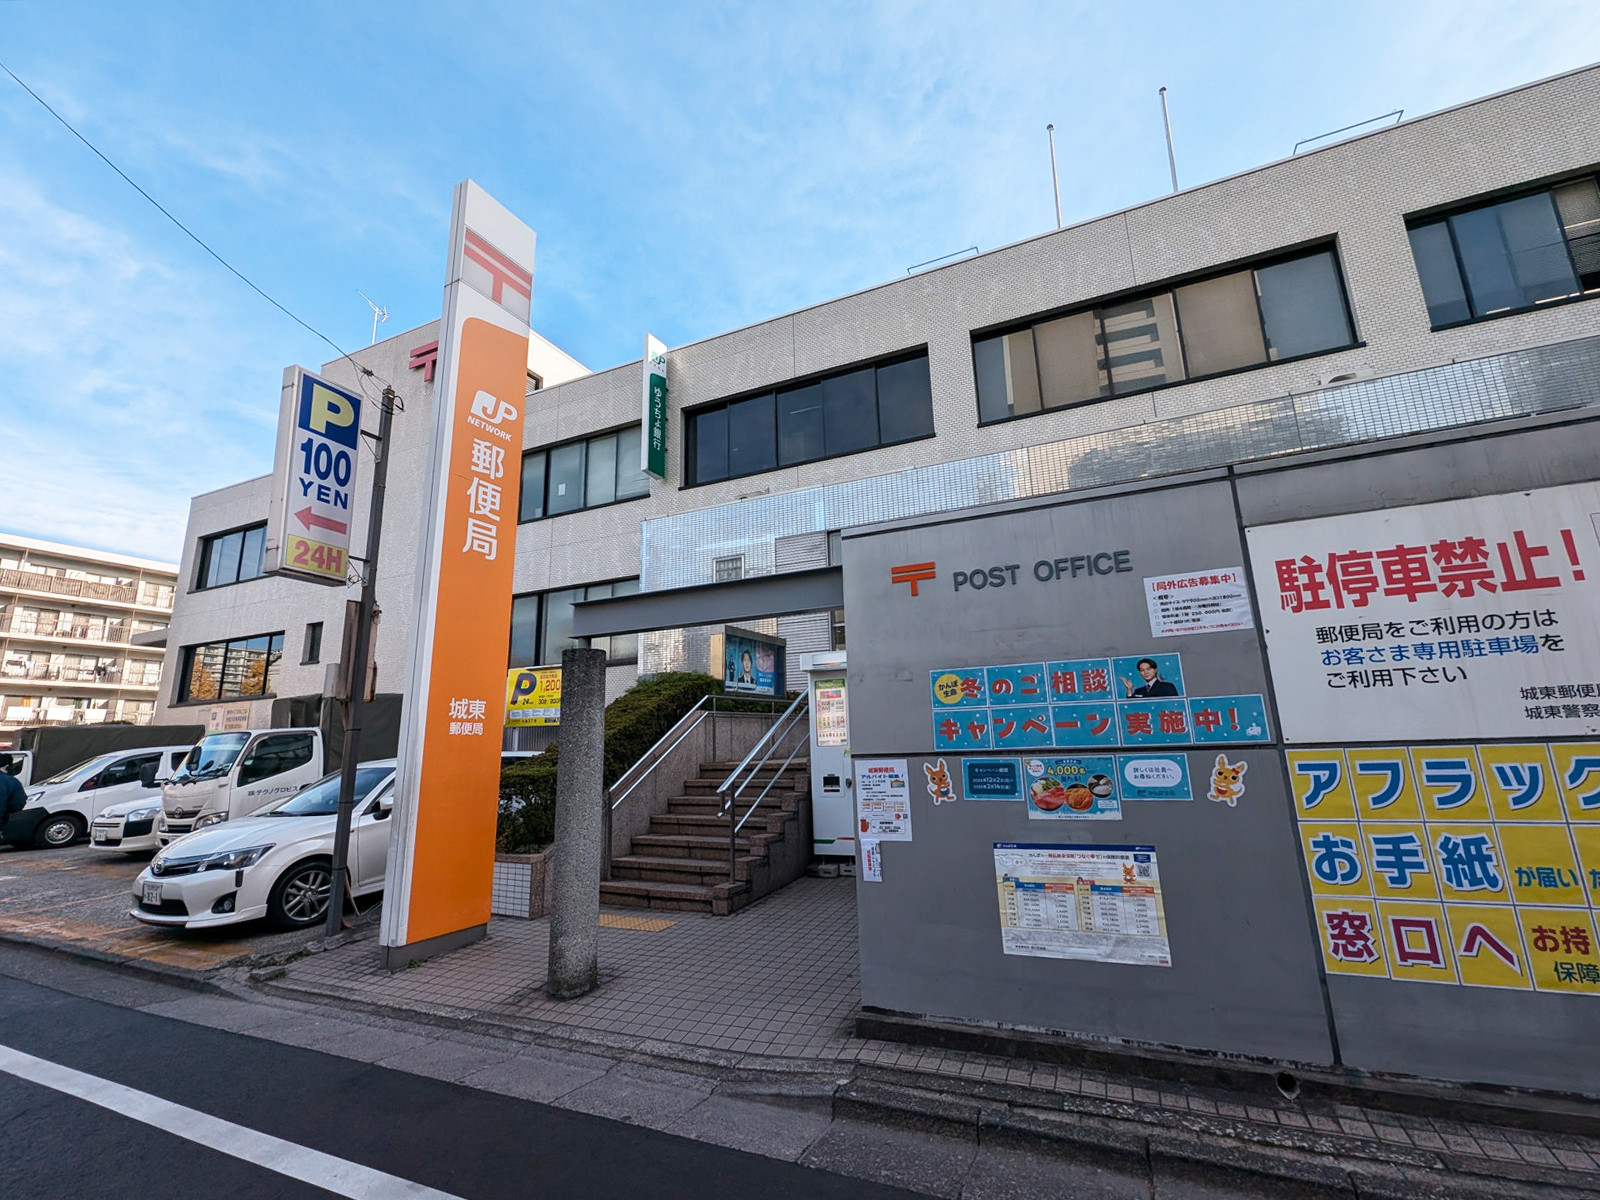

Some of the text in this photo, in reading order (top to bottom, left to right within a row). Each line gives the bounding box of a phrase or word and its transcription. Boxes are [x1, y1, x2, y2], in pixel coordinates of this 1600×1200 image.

[309, 383, 355, 434] P
[467, 415, 512, 442] NETWORK
[300, 437, 352, 487] 100
[298, 477, 349, 510] YEN
[462, 438, 505, 561] 郵便局
[293, 540, 343, 573] 24H
[953, 550, 1133, 592] POST OFFICE
[1316, 608, 1559, 644] 郵便局をご利用の方は
[1321, 633, 1565, 667] お客さま専用駐車場を
[938, 680, 958, 690] かんぽ
[943, 689, 957, 698] 生命
[960, 668, 1109, 698] 冬のご相談
[1326, 666, 1468, 689] ご利用下さい
[1520, 684, 1600, 700] 城東郵便
[448, 698, 487, 720] 城東
[449, 722, 483, 735] 郵便局
[1294, 756, 1600, 810] アフラック
[1322, 908, 1522, 977] 窓口へ
[1531, 925, 1590, 955] お持
